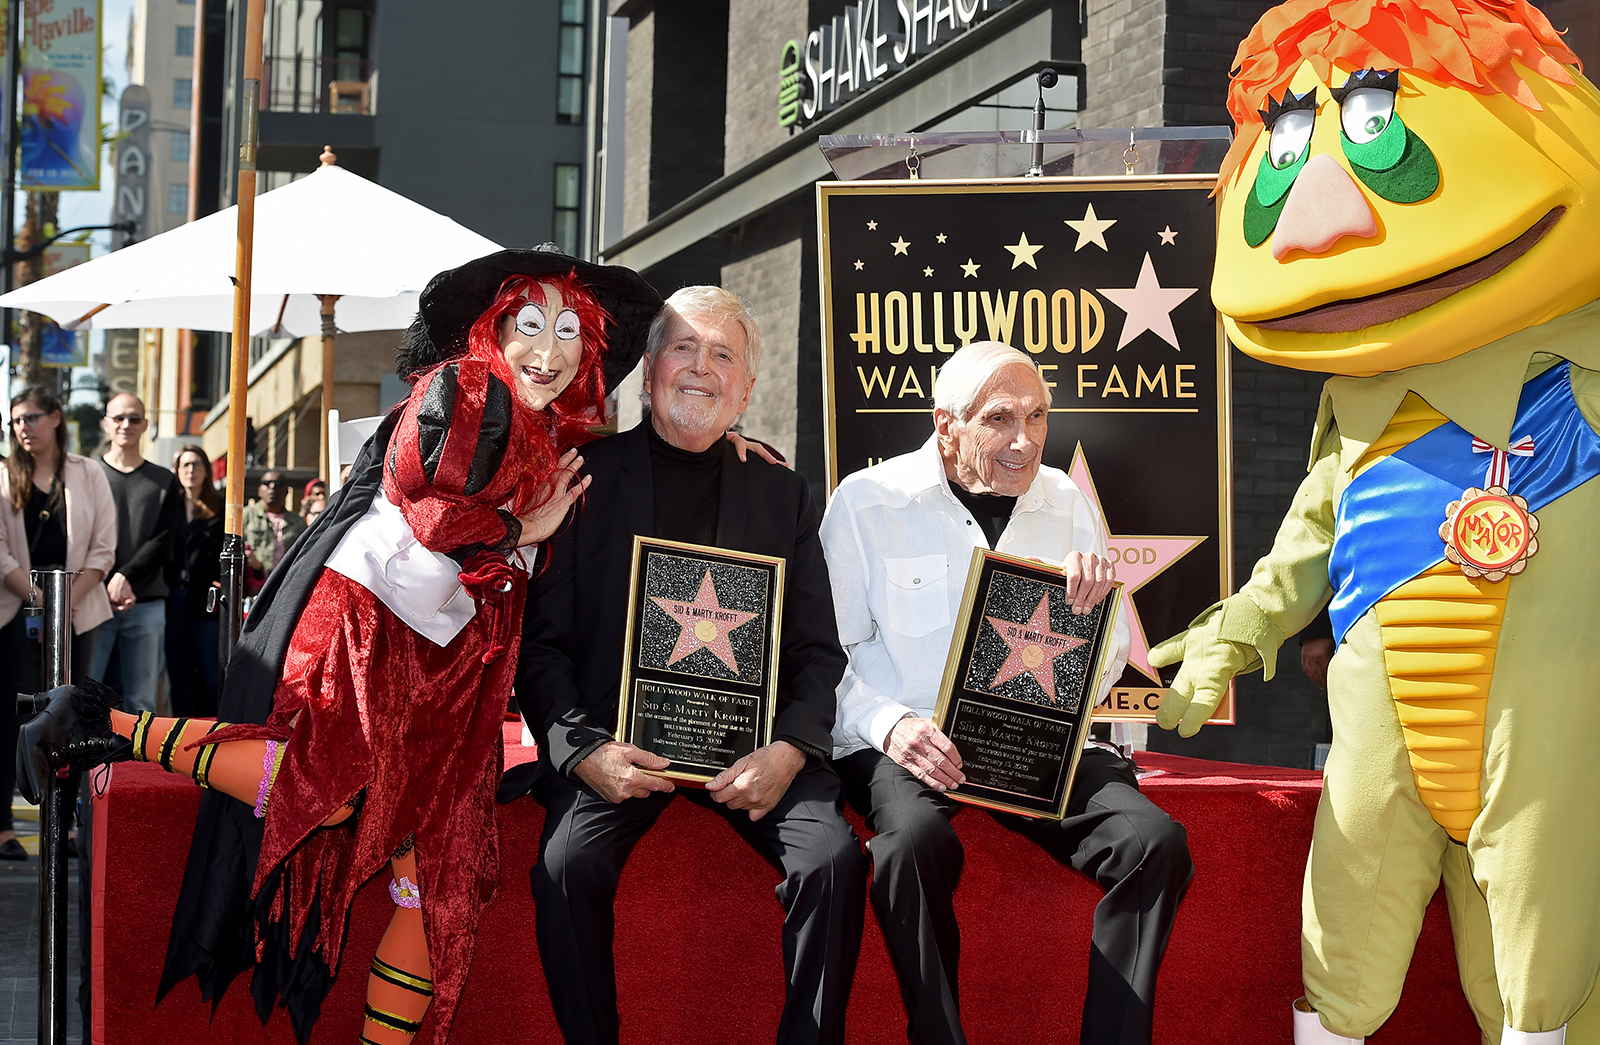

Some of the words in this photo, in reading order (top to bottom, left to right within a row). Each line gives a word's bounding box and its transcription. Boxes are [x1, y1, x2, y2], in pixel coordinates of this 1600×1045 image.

[803, 0, 888, 119] SHAKE
[850, 288, 1105, 354] HOLLYWOOD
[1037, 364, 1059, 398] F
[1077, 364, 1198, 398] FAME
[1459, 511, 1522, 556] MAYOR
[673, 604, 684, 615] SID
[685, 606, 690, 616] &
[692, 607, 713, 619] MARTY
[714, 611, 738, 623] KROFFT
[1006, 626, 1018, 638] SID
[1024, 630, 1044, 643] MARTY
[1045, 635, 1067, 649] KROFFT
[641, 684, 691, 698] HOLLYWOOD
[693, 691, 717, 701] WALK
[718, 695, 730, 703] OF
[731, 697, 754, 707] FAME
[662, 702, 671, 712] &
[663, 723, 692, 733] HOLLYWOOD
[692, 727, 706, 735] WALK
[961, 704, 1008, 720] HOLLYWOOD
[1010, 715, 1032, 727] WALK
[1033, 720, 1045, 728] OF
[1045, 723, 1067, 734] FAME
[978, 724, 987, 735] &
[652, 738, 678, 746] Hollywood
[679, 740, 701, 750] Chamber
[708, 745, 736, 755] Commerce
[667, 731, 694, 742] February
[705, 736, 723, 745] 2020
[978, 754, 1003, 767] February
